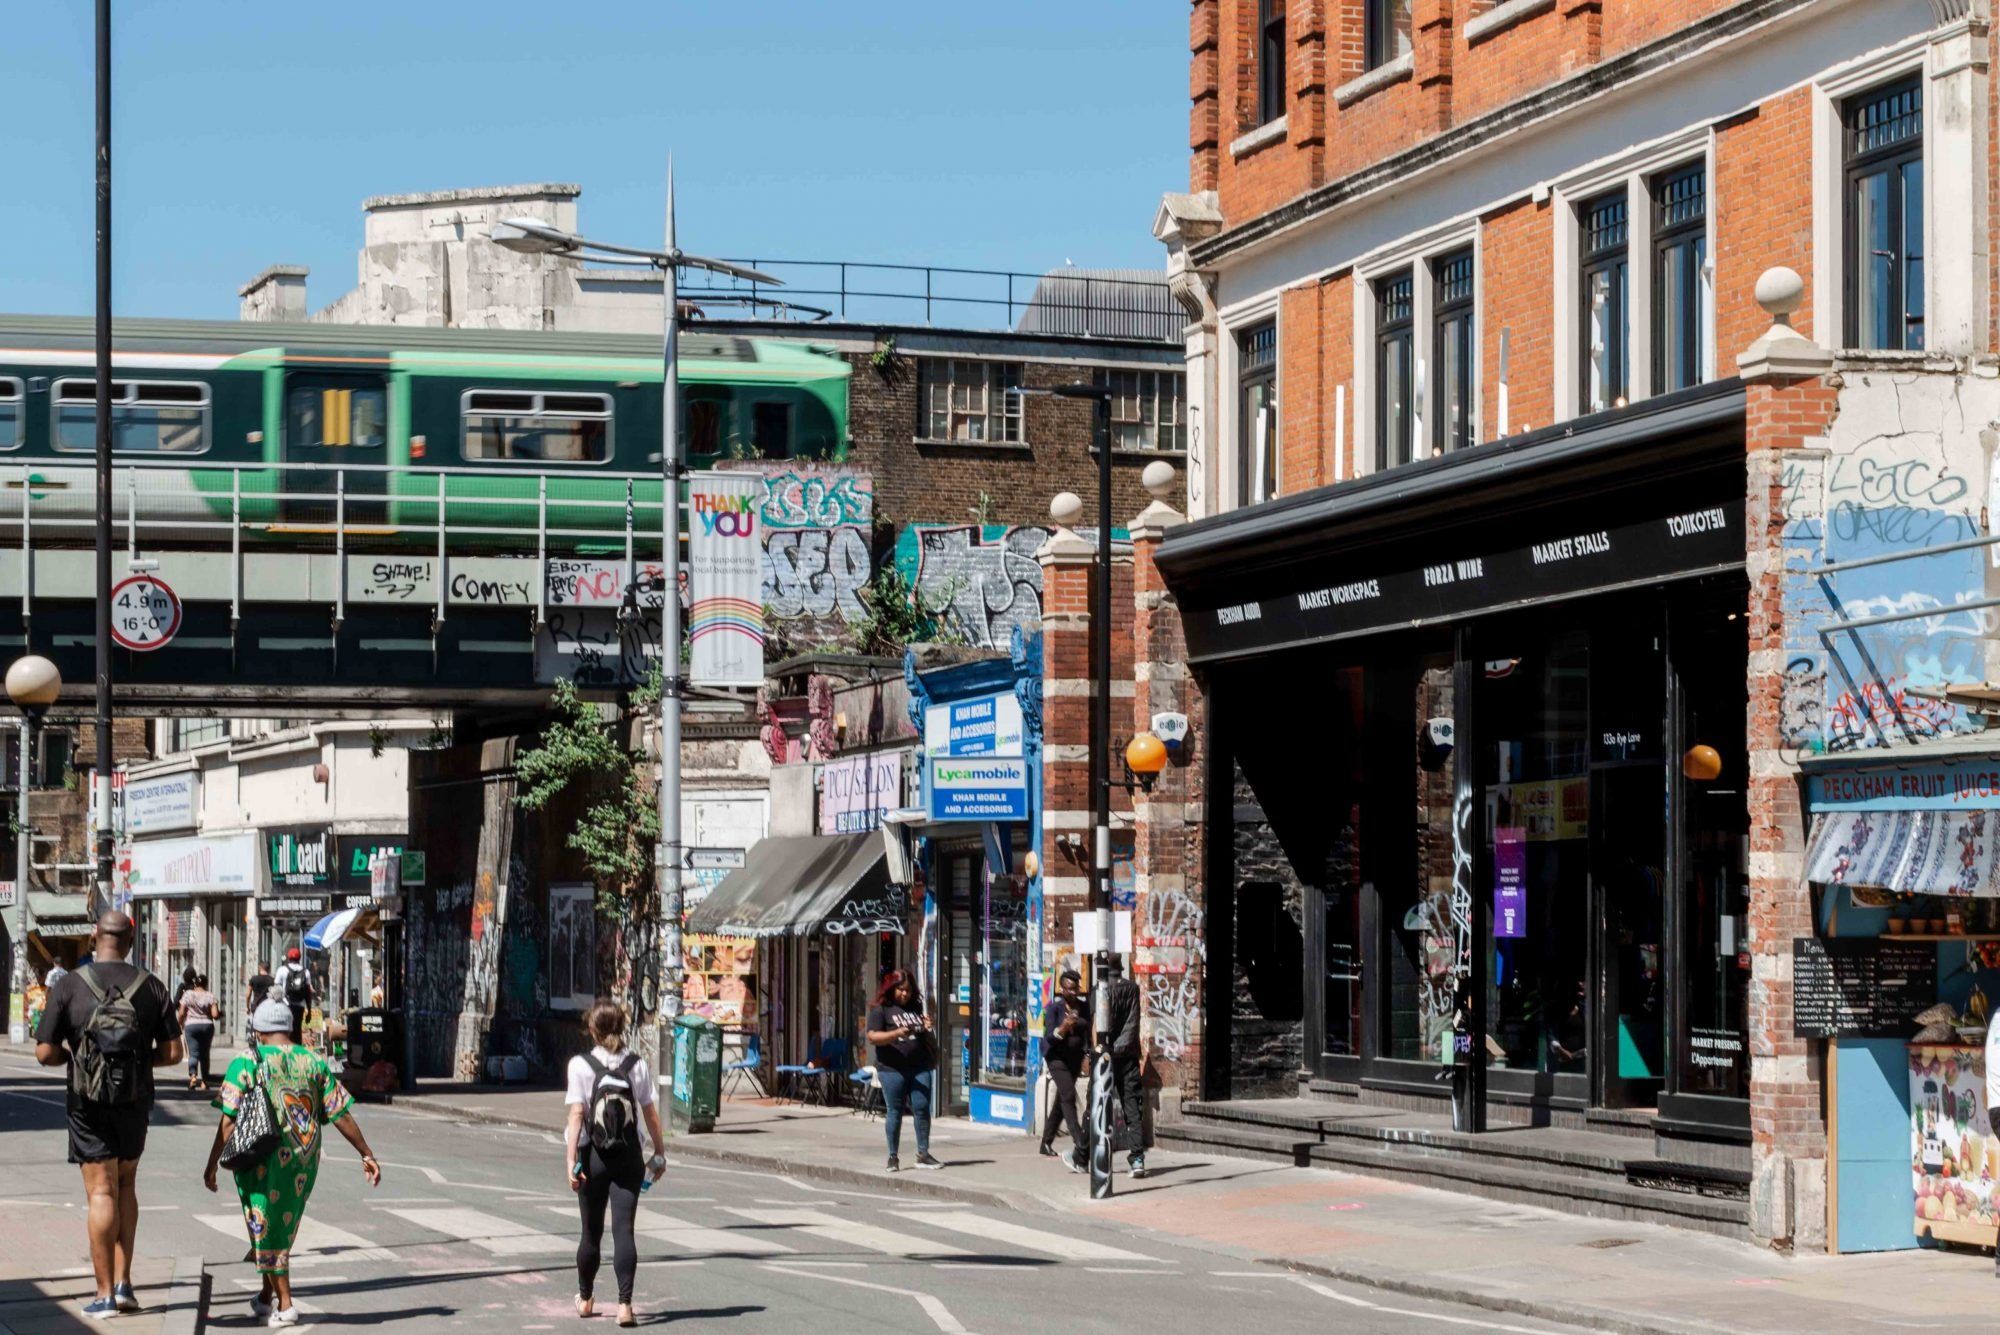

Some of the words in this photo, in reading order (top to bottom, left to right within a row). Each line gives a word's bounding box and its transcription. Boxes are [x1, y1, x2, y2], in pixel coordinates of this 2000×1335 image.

[692, 494, 756, 514] THANK
[699, 511, 753, 537] YOU
[1532, 537, 1573, 565] MARKET
[1574, 531, 1610, 557] STALLS
[709, 556, 755, 565] supporting
[714, 566, 757, 574] businesses
[1424, 563, 1455, 586] FORZA
[1457, 558, 1483, 580] WINE
[451, 574, 529, 603] COMFY
[1298, 588, 1331, 611] MARKET
[1330, 579, 1380, 605] WORKSPACE
[1217, 605, 1244, 625] PECKHAM
[1244, 602, 1261, 621] AUDIO
[971, 702, 992, 718] MOBILE
[937, 767, 1020, 781] Lycamobile
[952, 793, 975, 802] KHAN
[976, 793, 1007, 802] MOBILE
[1823, 776, 1896, 800] PECKHAM
[1901, 774, 1945, 798] FRUIT
[944, 804, 962, 814] AND
[963, 804, 1014, 814] ACCESORIES
[272, 833, 326, 874] billboard
[1691, 1036, 1713, 1048] MARKET
